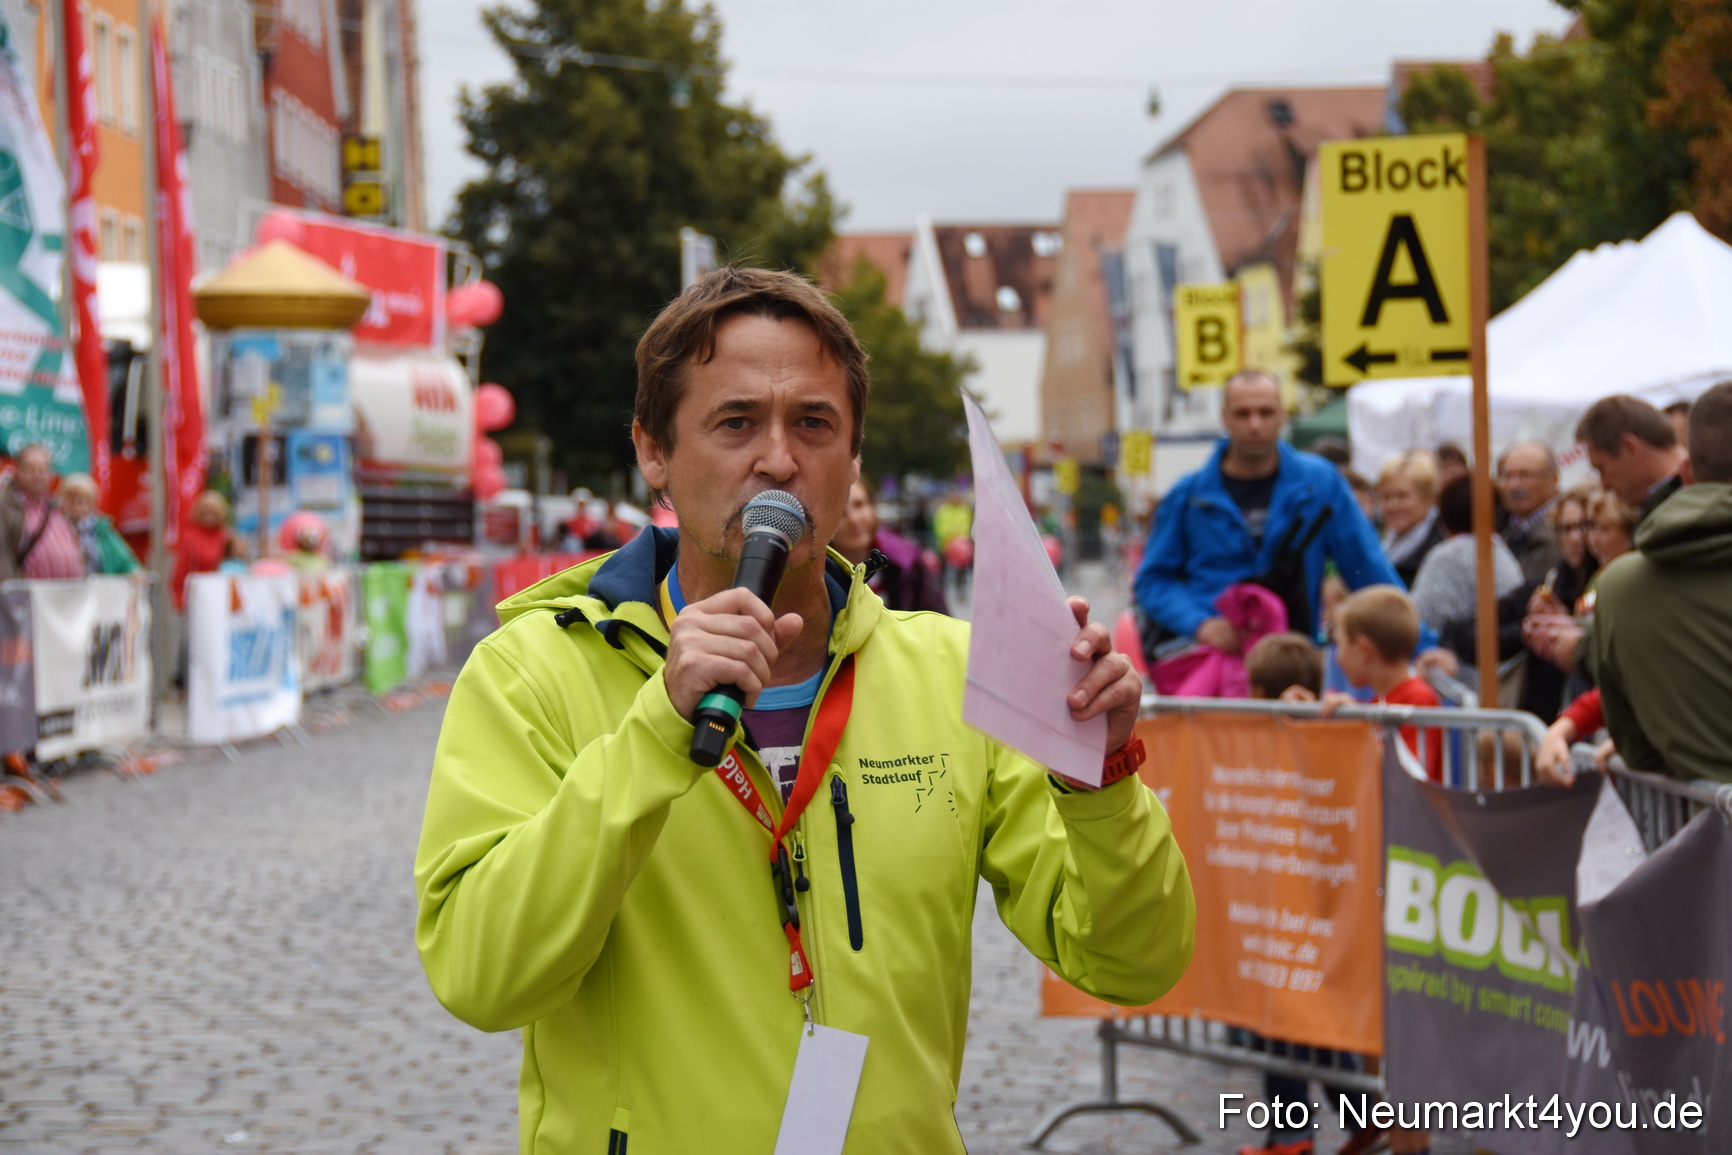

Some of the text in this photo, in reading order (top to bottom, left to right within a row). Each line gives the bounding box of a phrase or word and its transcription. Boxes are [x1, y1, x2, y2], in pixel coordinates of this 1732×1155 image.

[1339, 146, 1468, 193] Block
[1359, 213, 1450, 329] A
[1196, 316, 1228, 363] B
[859, 754, 935, 769] Neumarkter
[861, 770, 922, 785] Stadtlauf
[1451, 973, 1474, 1014] by
[1478, 986, 1532, 1023] smart
